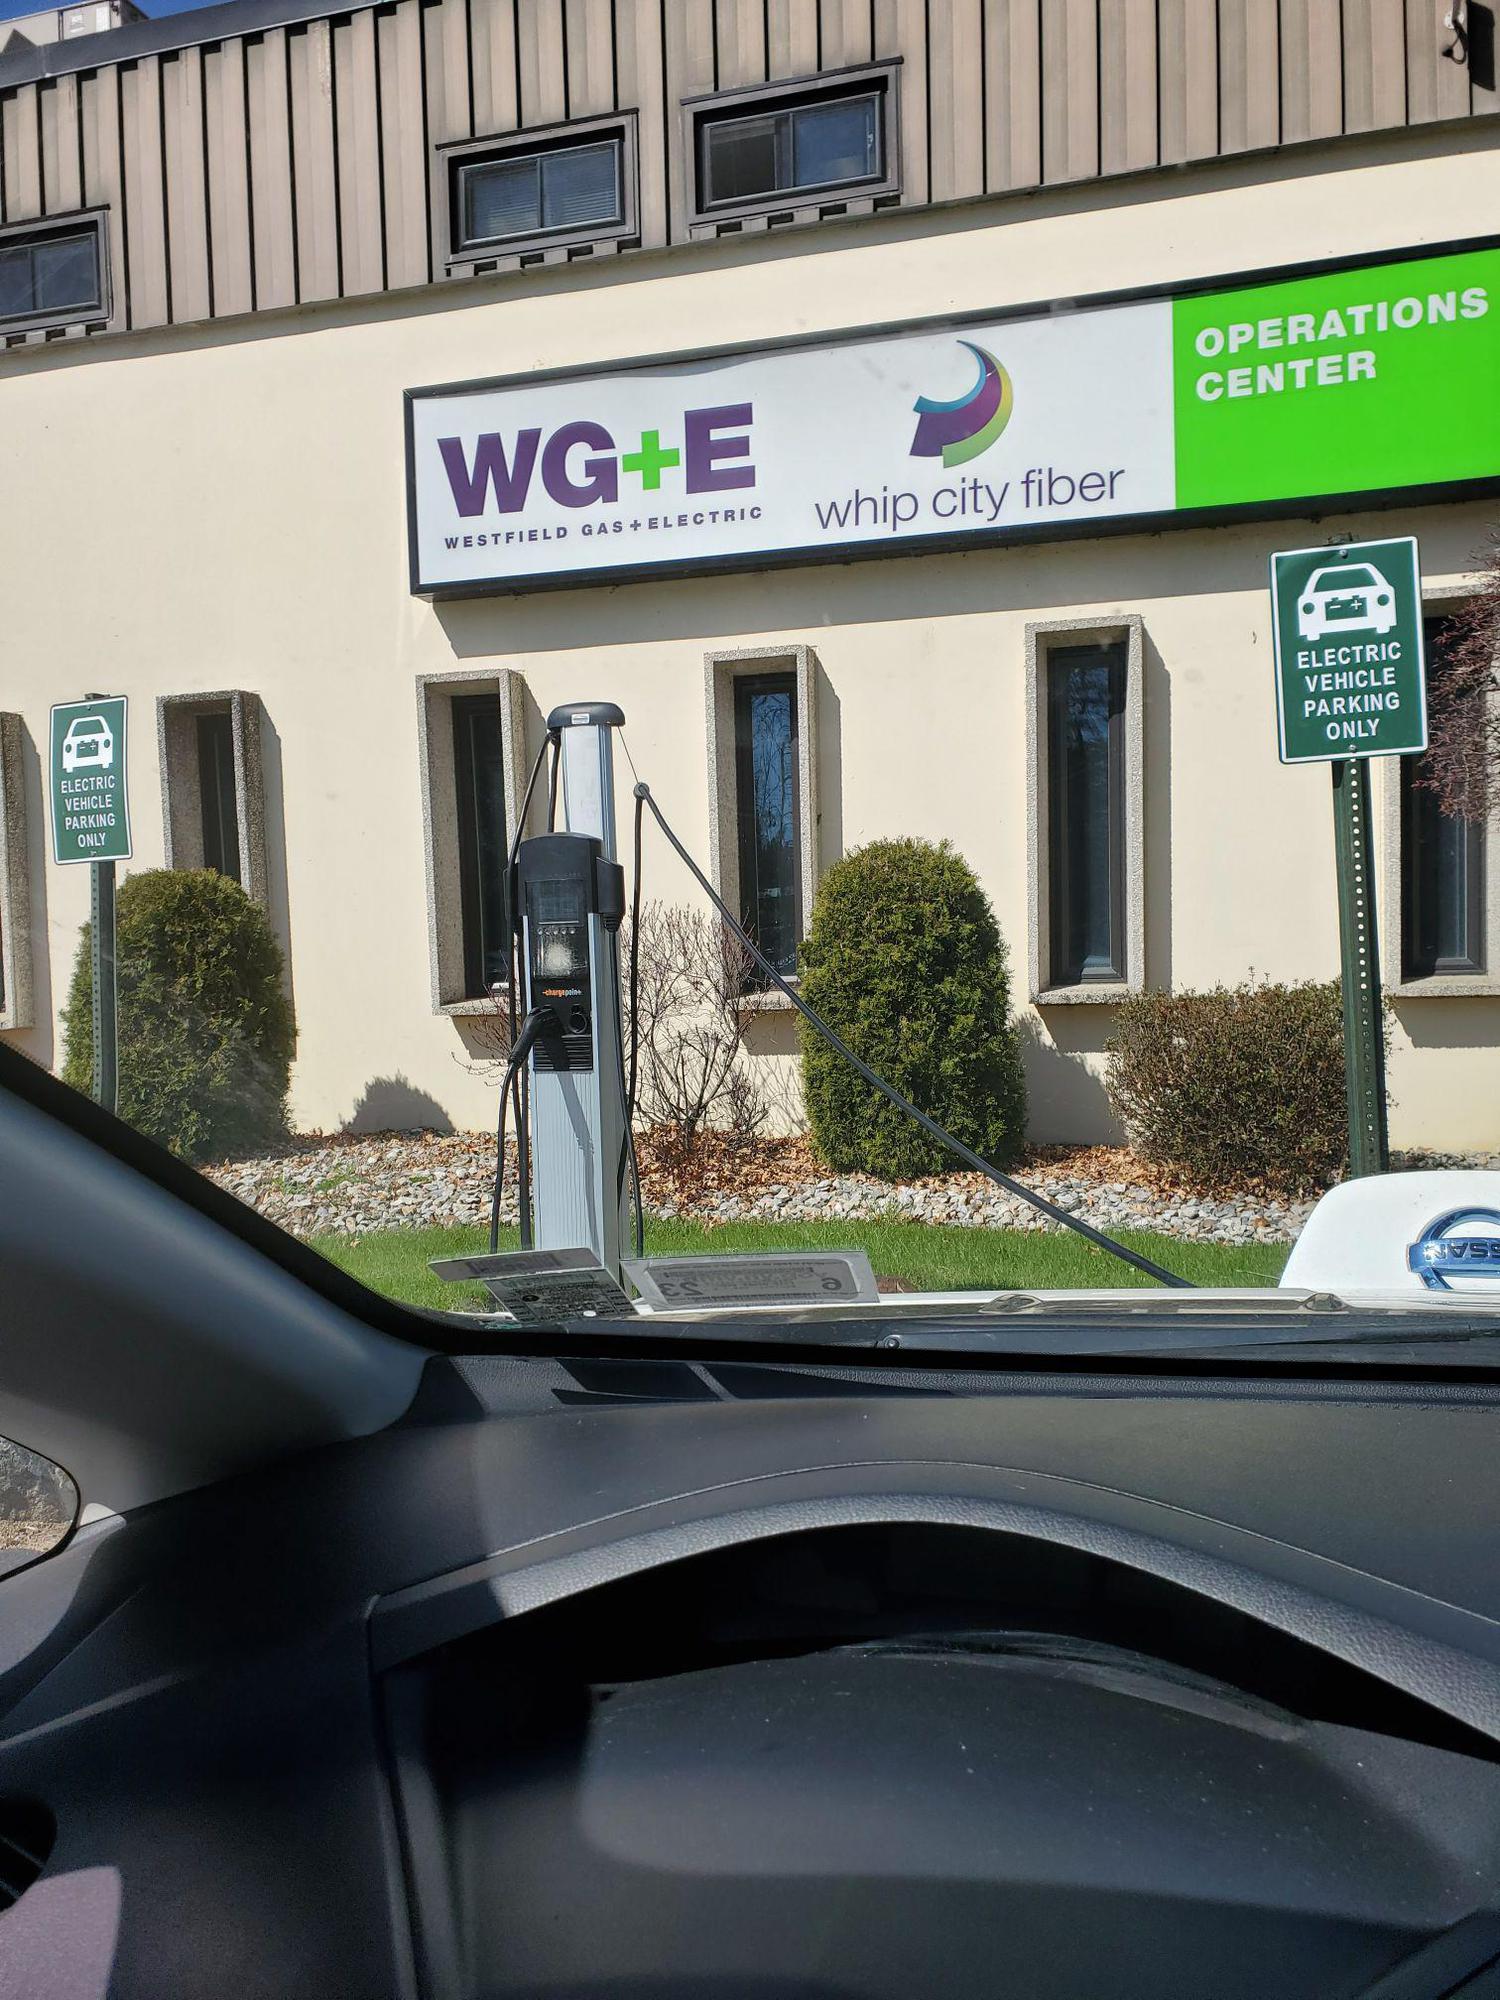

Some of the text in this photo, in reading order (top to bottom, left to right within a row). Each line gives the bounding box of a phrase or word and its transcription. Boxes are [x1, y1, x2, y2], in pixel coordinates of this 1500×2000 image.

[1195, 287, 1489, 357] OPERATIONS
[1196, 350, 1377, 401] CENTER
[437, 402, 756, 518] WG+E
[814, 466, 1126, 531] whip city fiber
[445, 526, 568, 550] WESTFIELD
[1297, 641, 1402, 669] ELECTRIC
[1305, 667, 1396, 693] VEHICLE
[1304, 691, 1400, 718] PARKING
[1326, 718, 1380, 740] ONLY
[61, 775, 116, 794] ELECTRIC
[65, 794, 113, 812] VEHICLE
[65, 812, 116, 830] PARKING
[77, 832, 106, 848] ONLY
